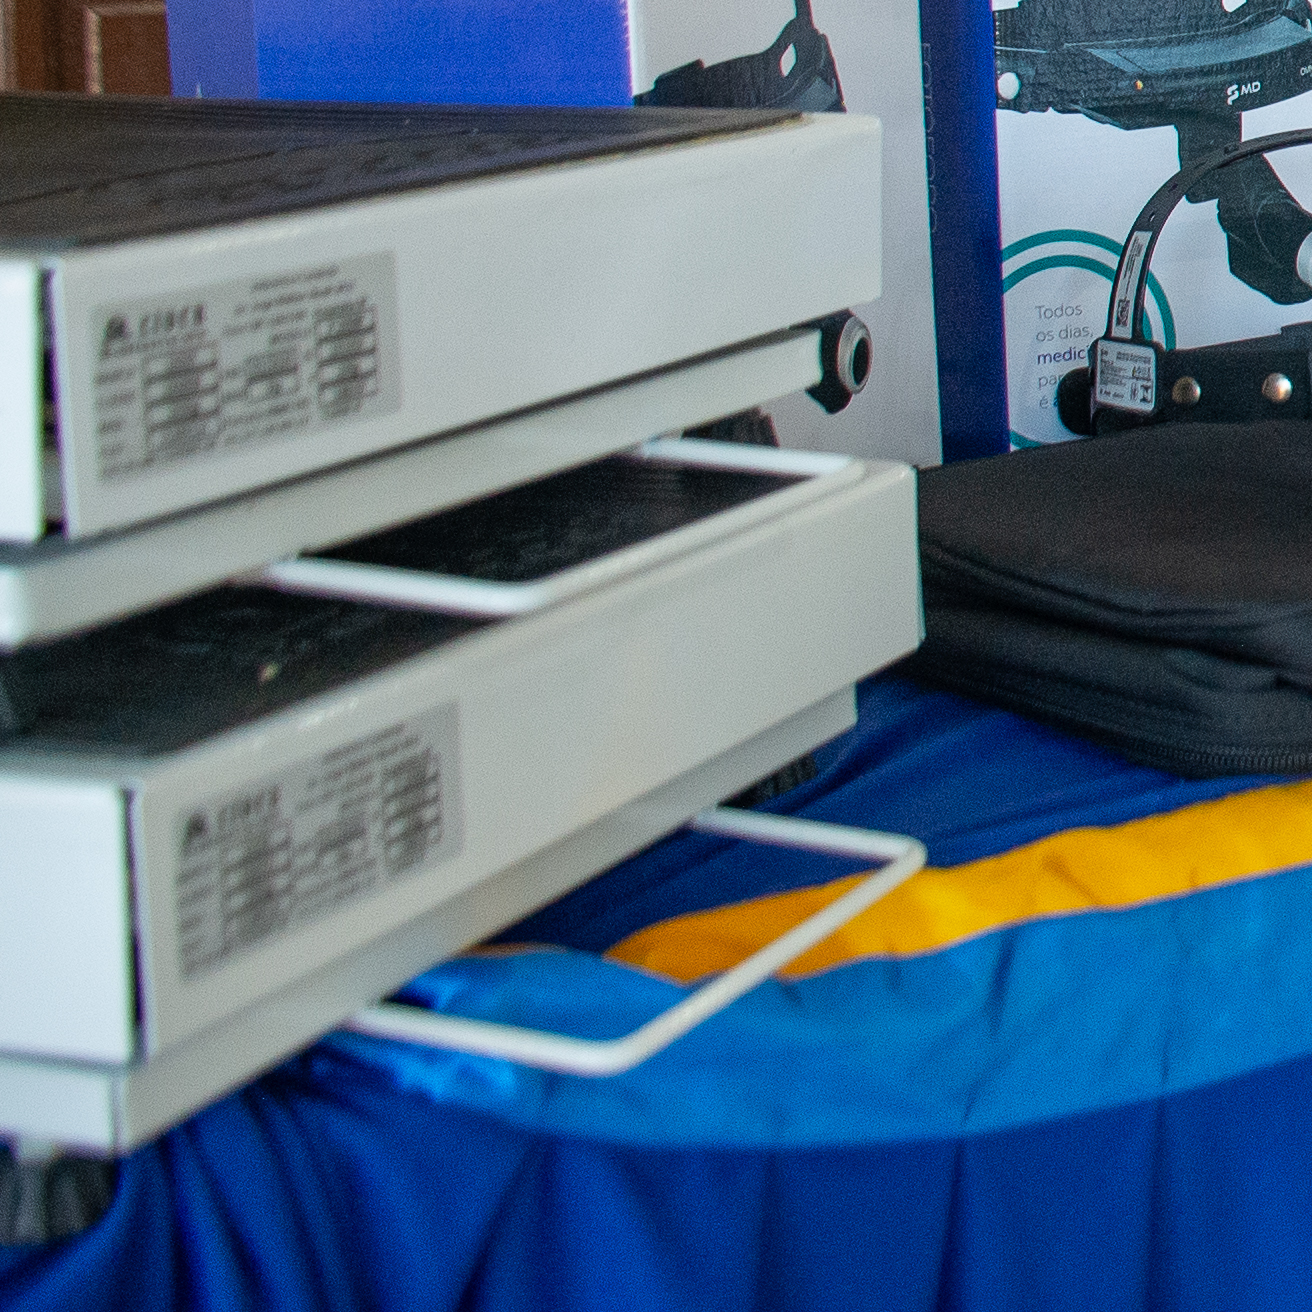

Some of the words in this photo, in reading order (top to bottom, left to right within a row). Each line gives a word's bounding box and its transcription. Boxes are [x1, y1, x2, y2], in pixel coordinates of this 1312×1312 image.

[1240, 81, 1261, 96] MD
[1035, 303, 1083, 320] Todos
[1035, 330, 1054, 342] os
[1058, 325, 1094, 340] dias,
[1037, 346, 1090, 365] medic
